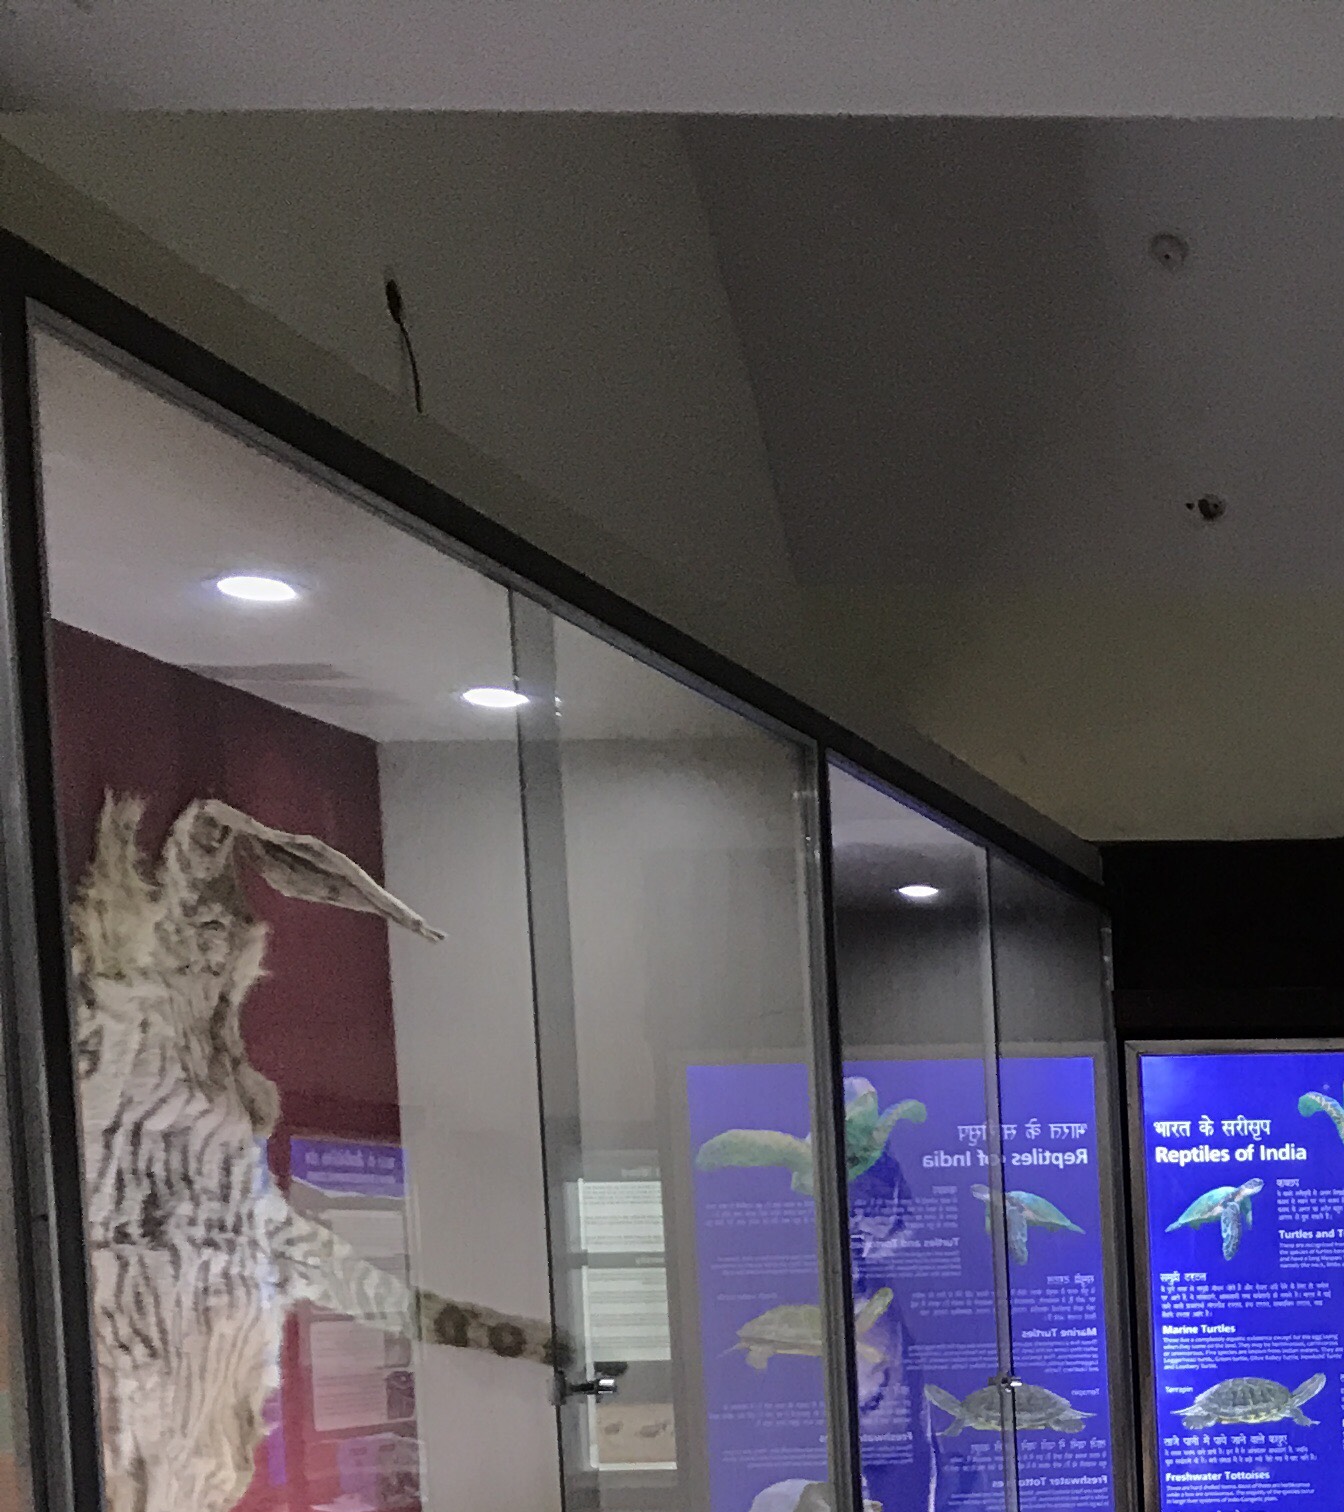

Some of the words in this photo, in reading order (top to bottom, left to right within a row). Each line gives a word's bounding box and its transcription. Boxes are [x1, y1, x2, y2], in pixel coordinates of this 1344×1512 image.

[1153, 1120, 1191, 1137] भारत
[1198, 1114, 1214, 1136] के
[1221, 1114, 1271, 1141] सरीसृप
[1155, 1145, 1230, 1167] Reptiles
[1235, 1144, 1254, 1161] of
[1260, 1143, 1307, 1161] India
[1279, 1230, 1313, 1239] Turtles
[1315, 1229, 1335, 1238] and
[1162, 1325, 1198, 1335] Marine
[1201, 1324, 1236, 1333] Turtles
[1165, 1472, 1222, 1482] Freshwater
